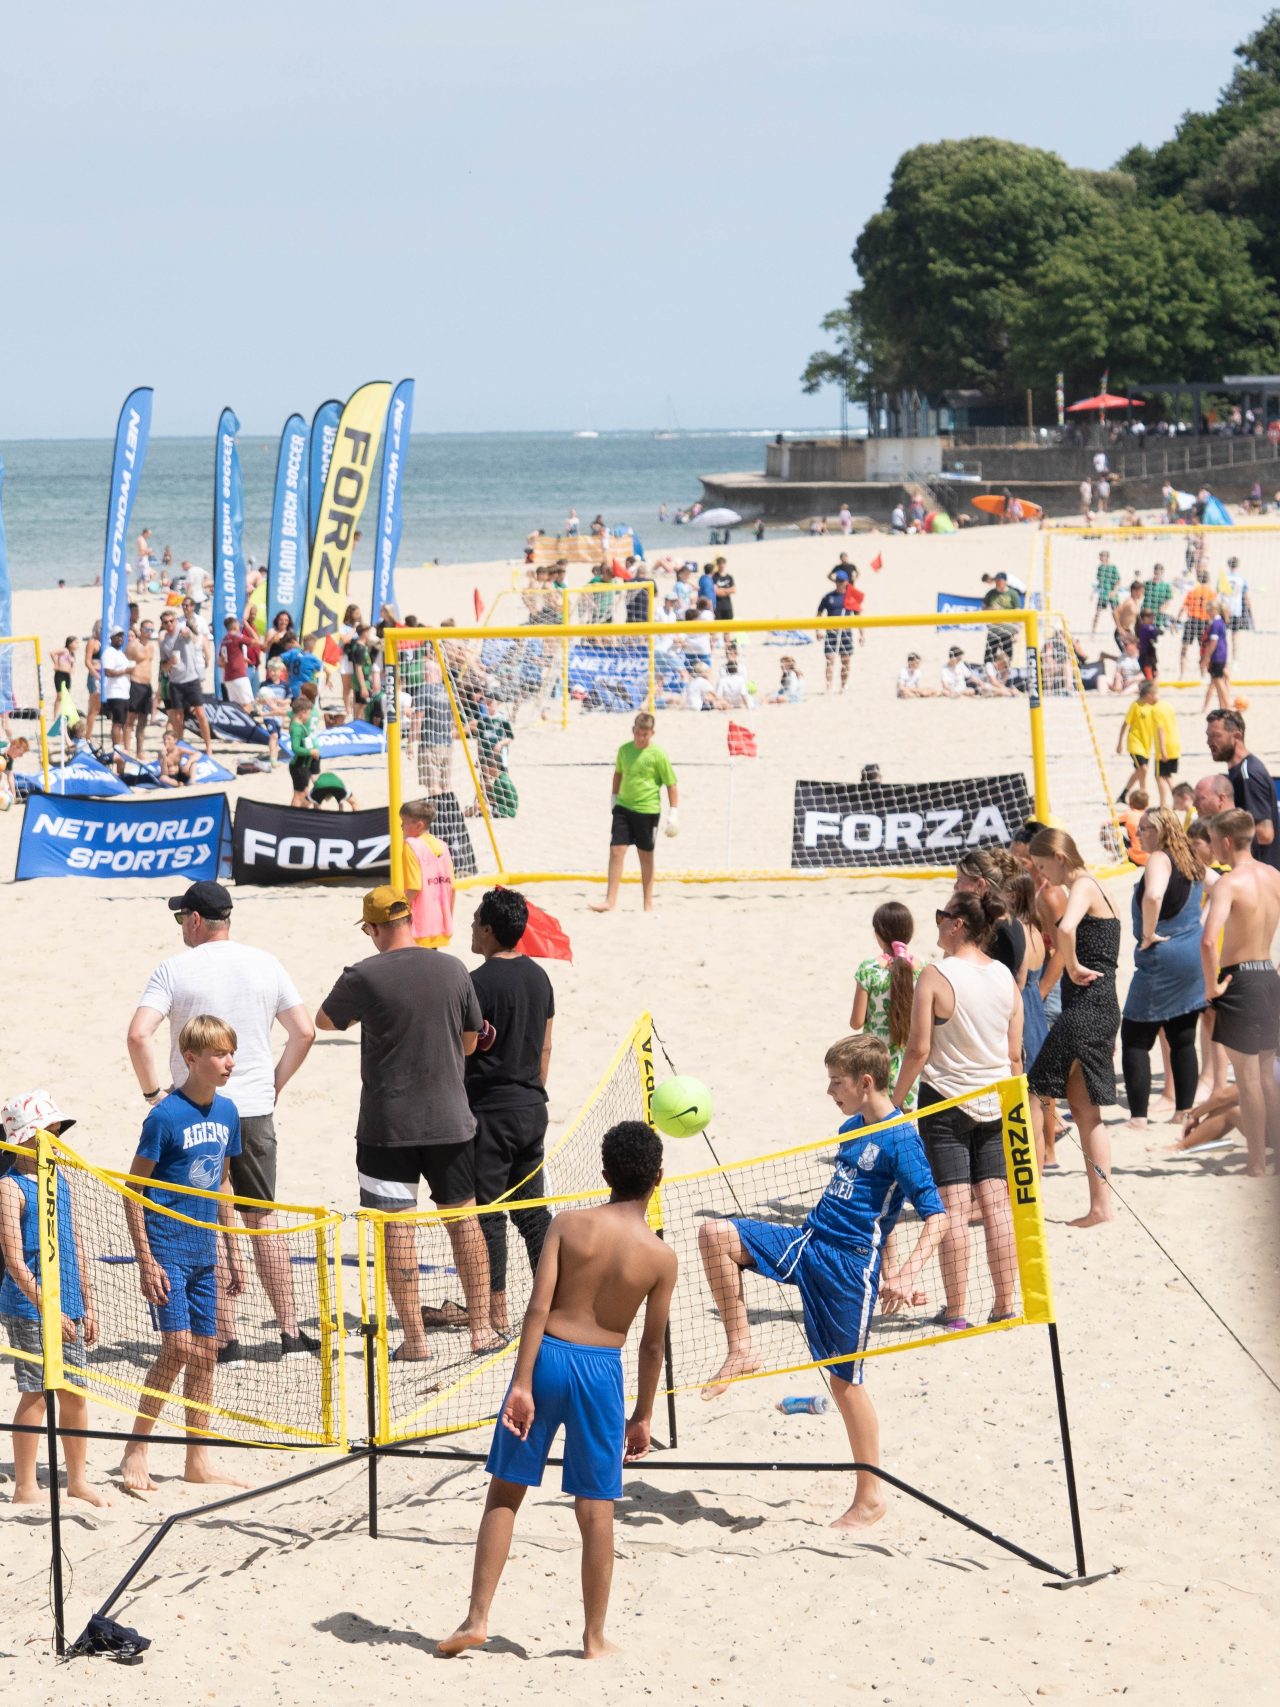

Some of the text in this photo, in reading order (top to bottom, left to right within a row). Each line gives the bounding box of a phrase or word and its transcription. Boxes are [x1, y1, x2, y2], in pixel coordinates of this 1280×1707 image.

[107, 407, 141, 636] NET WORLD SPO
[277, 433, 306, 605] ENGLAND BEACH SOCCER
[311, 426, 372, 637] FORZA
[386, 665, 396, 714] FORZA
[32, 813, 215, 843] NET WORLD
[66, 845, 193, 872] SPORTS
[243, 828, 391, 870] FORZ
[804, 805, 1011, 850] FORZA
[1008, 1102, 1037, 1205] FORZA
[44, 1157, 56, 1263] FORZA
